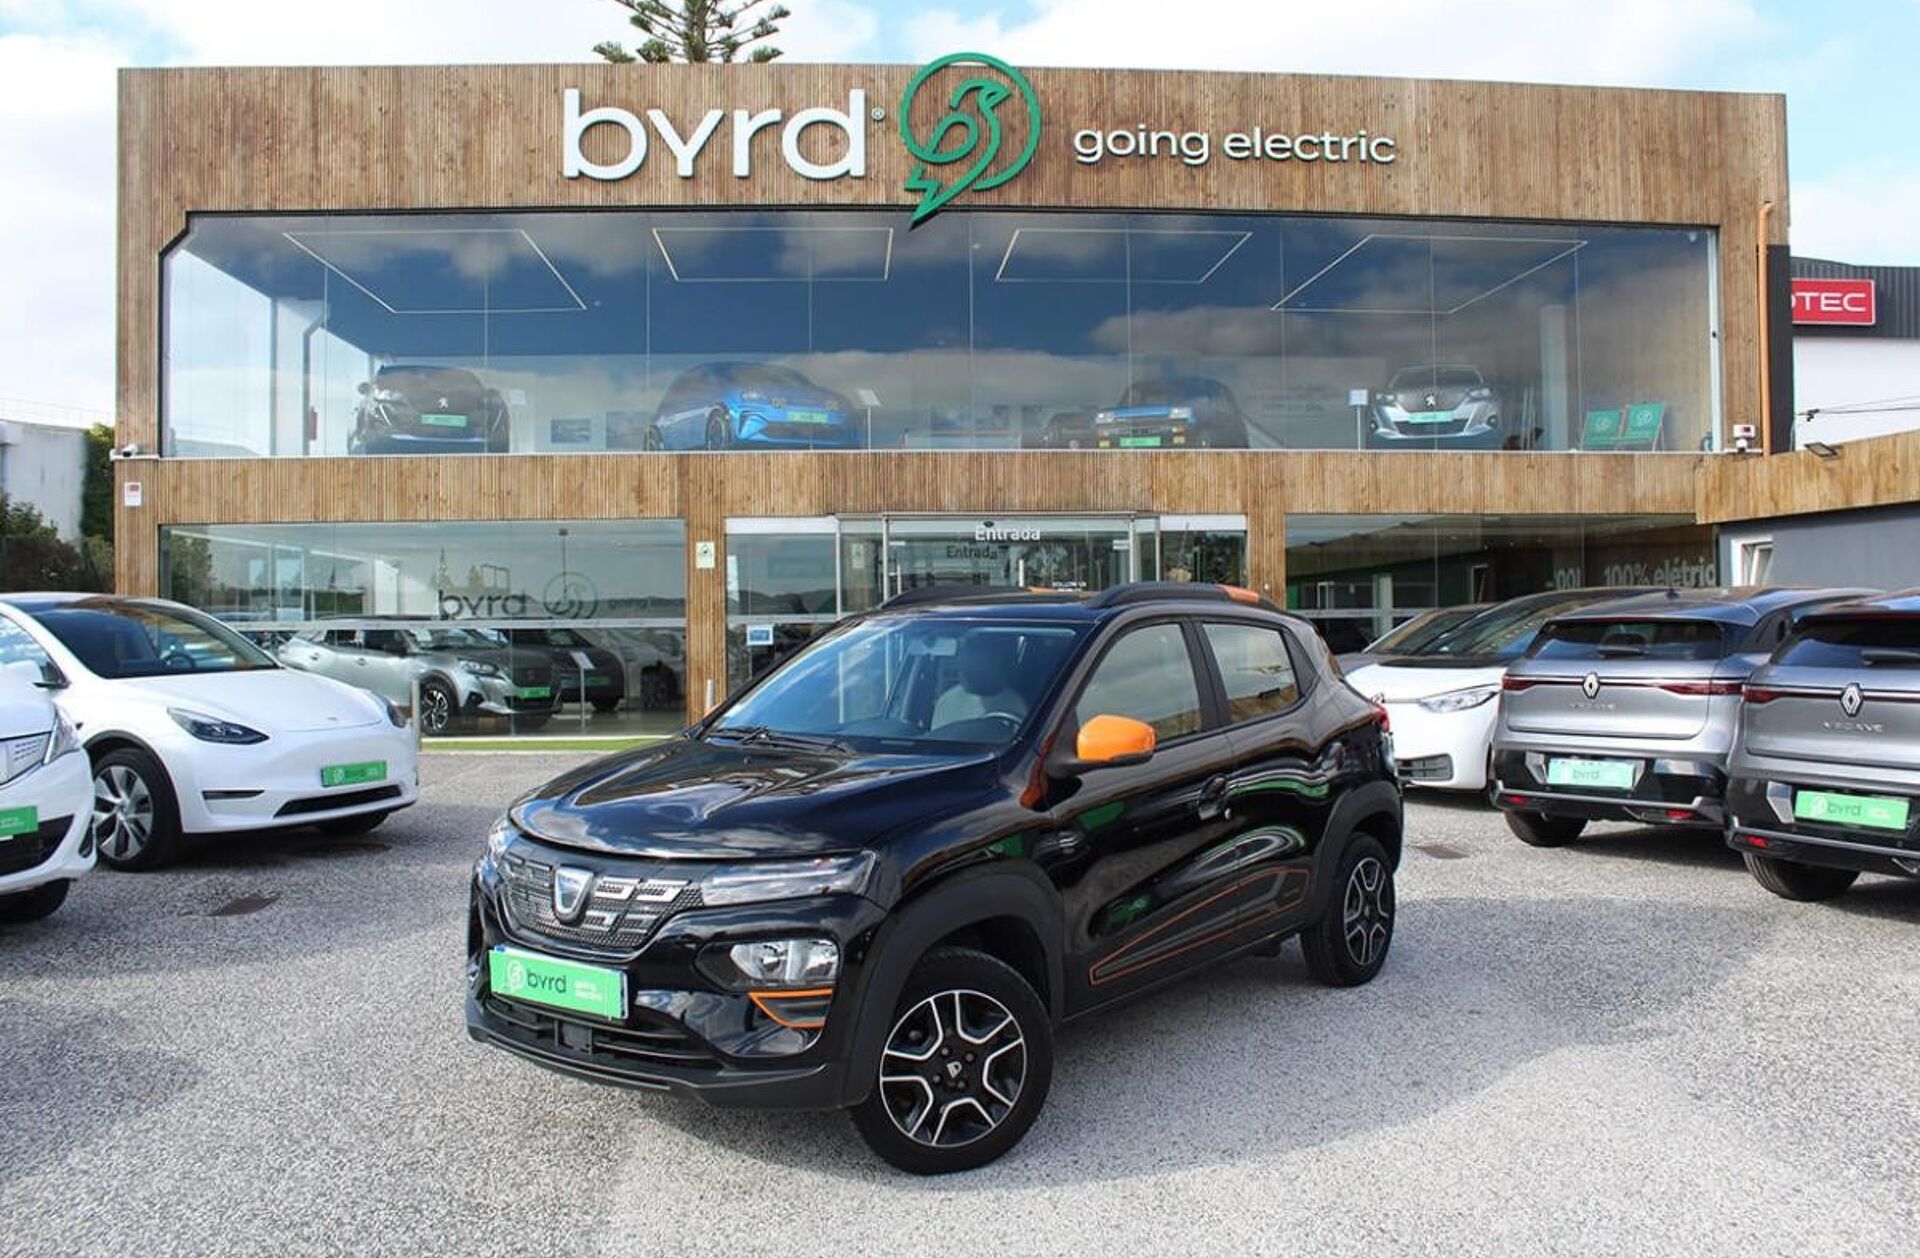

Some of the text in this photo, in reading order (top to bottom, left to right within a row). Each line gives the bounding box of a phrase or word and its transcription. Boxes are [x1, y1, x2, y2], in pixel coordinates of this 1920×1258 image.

[563, 88, 866, 180] byrd
[1073, 123, 1396, 164] going electric
[1791, 291, 1867, 312] TEC
[975, 526, 1041, 541] Entrada
[947, 545, 998, 559] Entrada
[1603, 563, 1649, 586] 100%
[438, 590, 527, 617] byrd
[1827, 801, 1862, 816] byrd
[526, 968, 567, 993] byrd
